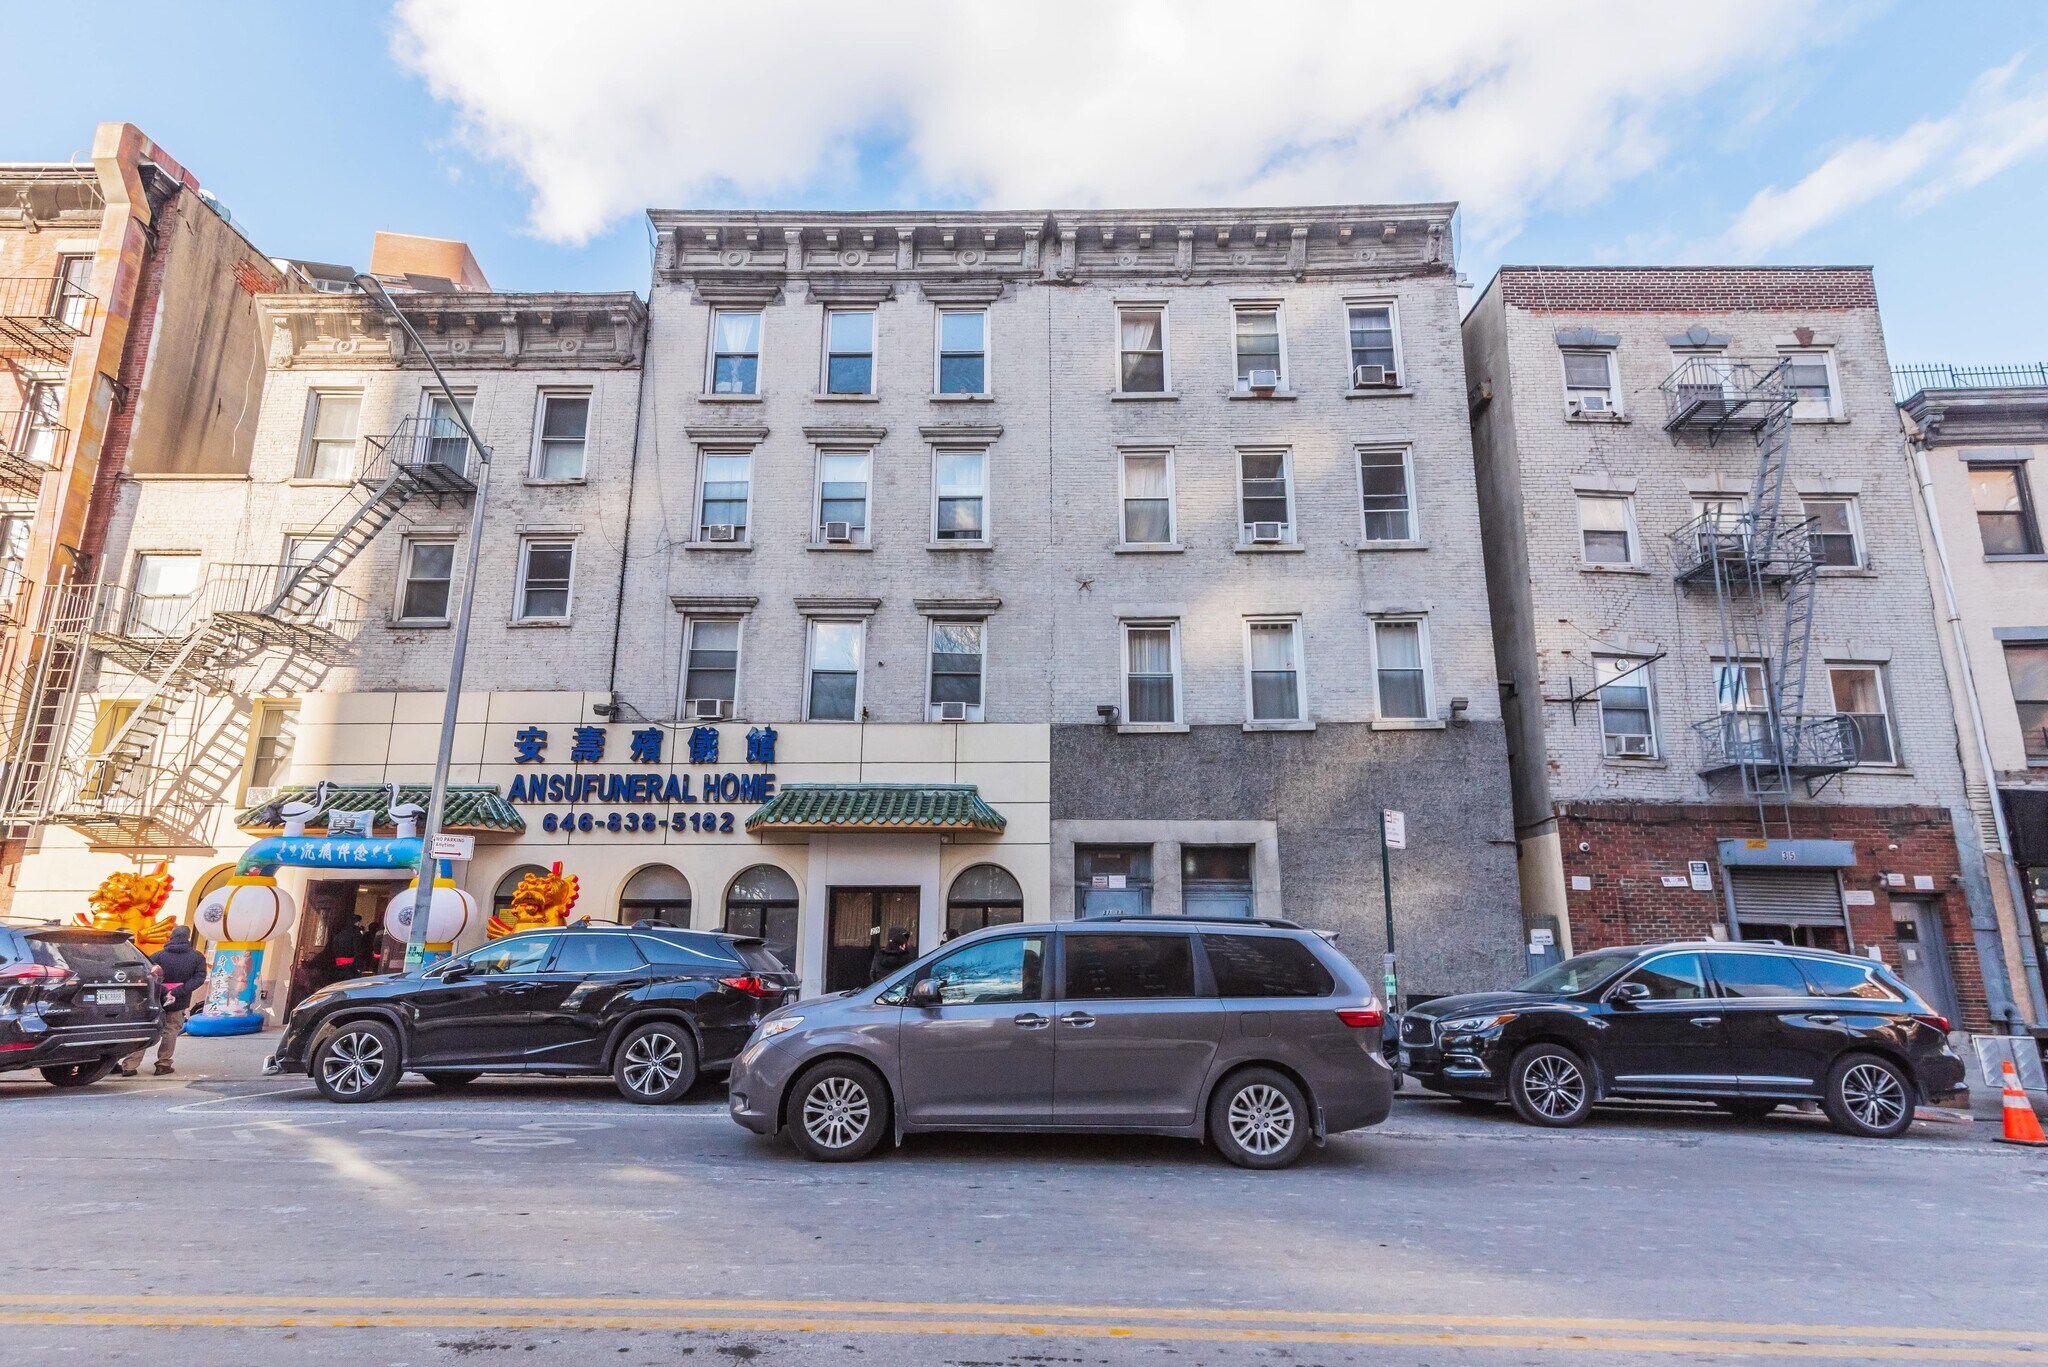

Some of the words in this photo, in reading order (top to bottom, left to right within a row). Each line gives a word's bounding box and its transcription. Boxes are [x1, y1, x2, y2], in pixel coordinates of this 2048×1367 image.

[514, 726, 778, 764] 安壽殯儀館
[703, 773, 776, 803] HOME
[542, 812, 735, 833] 646-838-5182
[1782, 851, 1796, 860] 35
